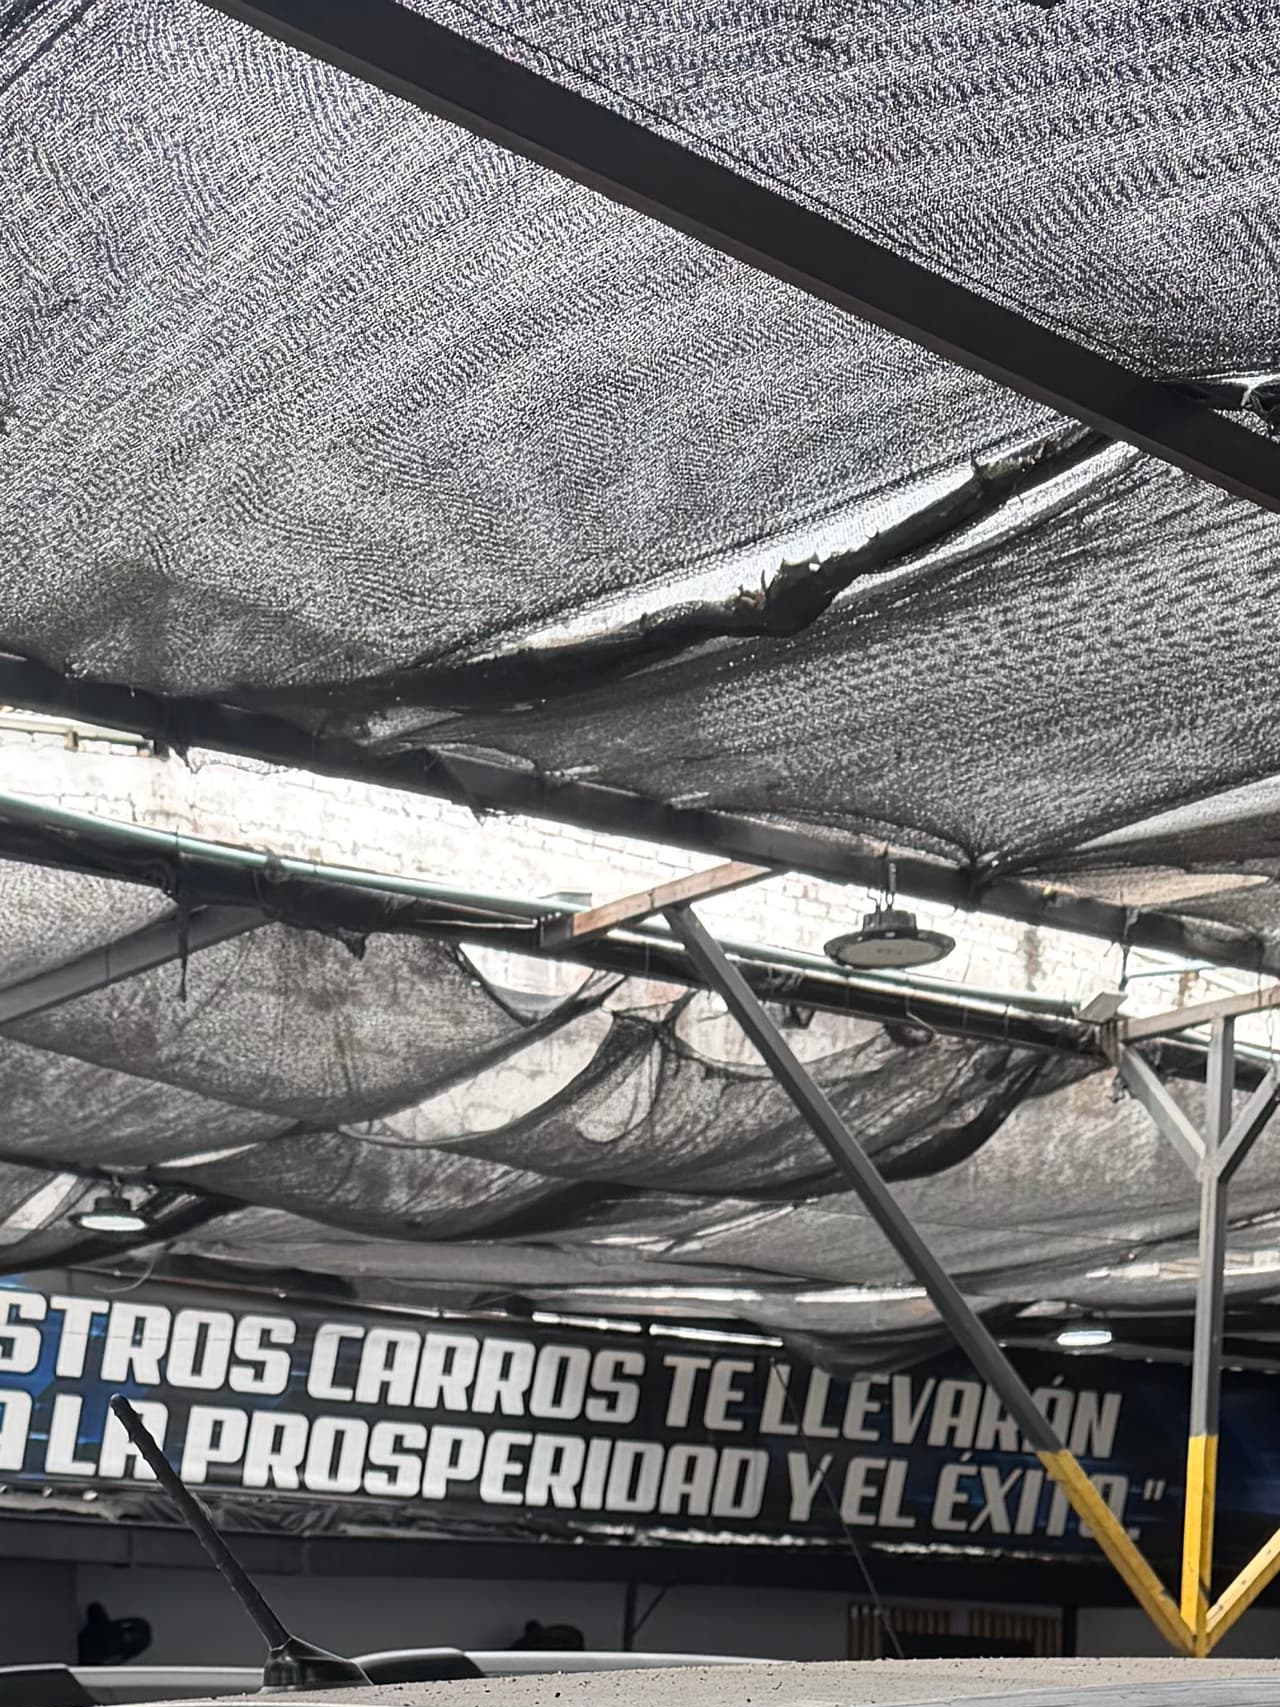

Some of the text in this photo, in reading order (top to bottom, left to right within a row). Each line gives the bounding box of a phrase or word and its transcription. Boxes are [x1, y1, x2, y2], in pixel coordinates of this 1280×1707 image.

[307, 1322, 646, 1424] CARROS
[662, 1355, 755, 1431] TE
[759, 1363, 1123, 1459] LLEVARÁN
[45, 1393, 169, 1481] LA
[179, 1404, 770, 1520] PROSPERIDAD
[786, 1451, 833, 1522] Y
[839, 1455, 917, 1529] EL
